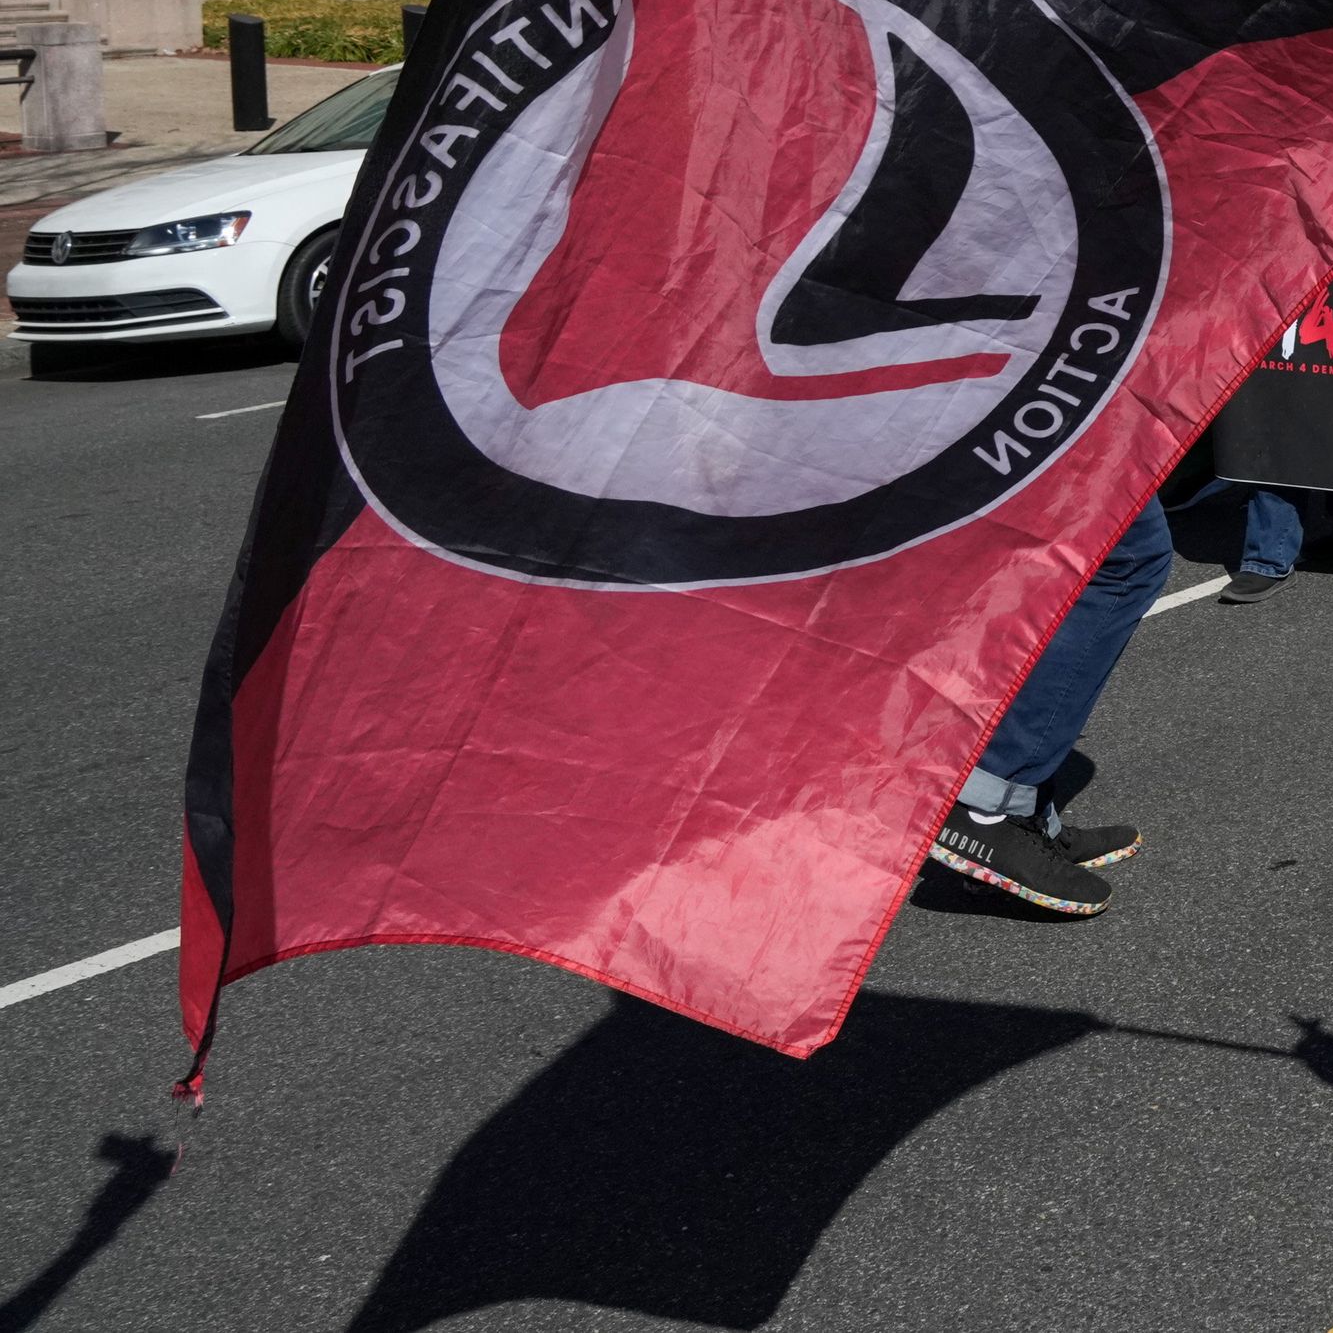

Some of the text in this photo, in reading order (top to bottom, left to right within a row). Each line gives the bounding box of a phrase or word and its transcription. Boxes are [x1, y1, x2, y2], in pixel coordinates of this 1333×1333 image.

[1258, 361, 1294, 372] ARCH
[1299, 362, 1307, 372] 4
[938, 827, 995, 864] NOBULL
